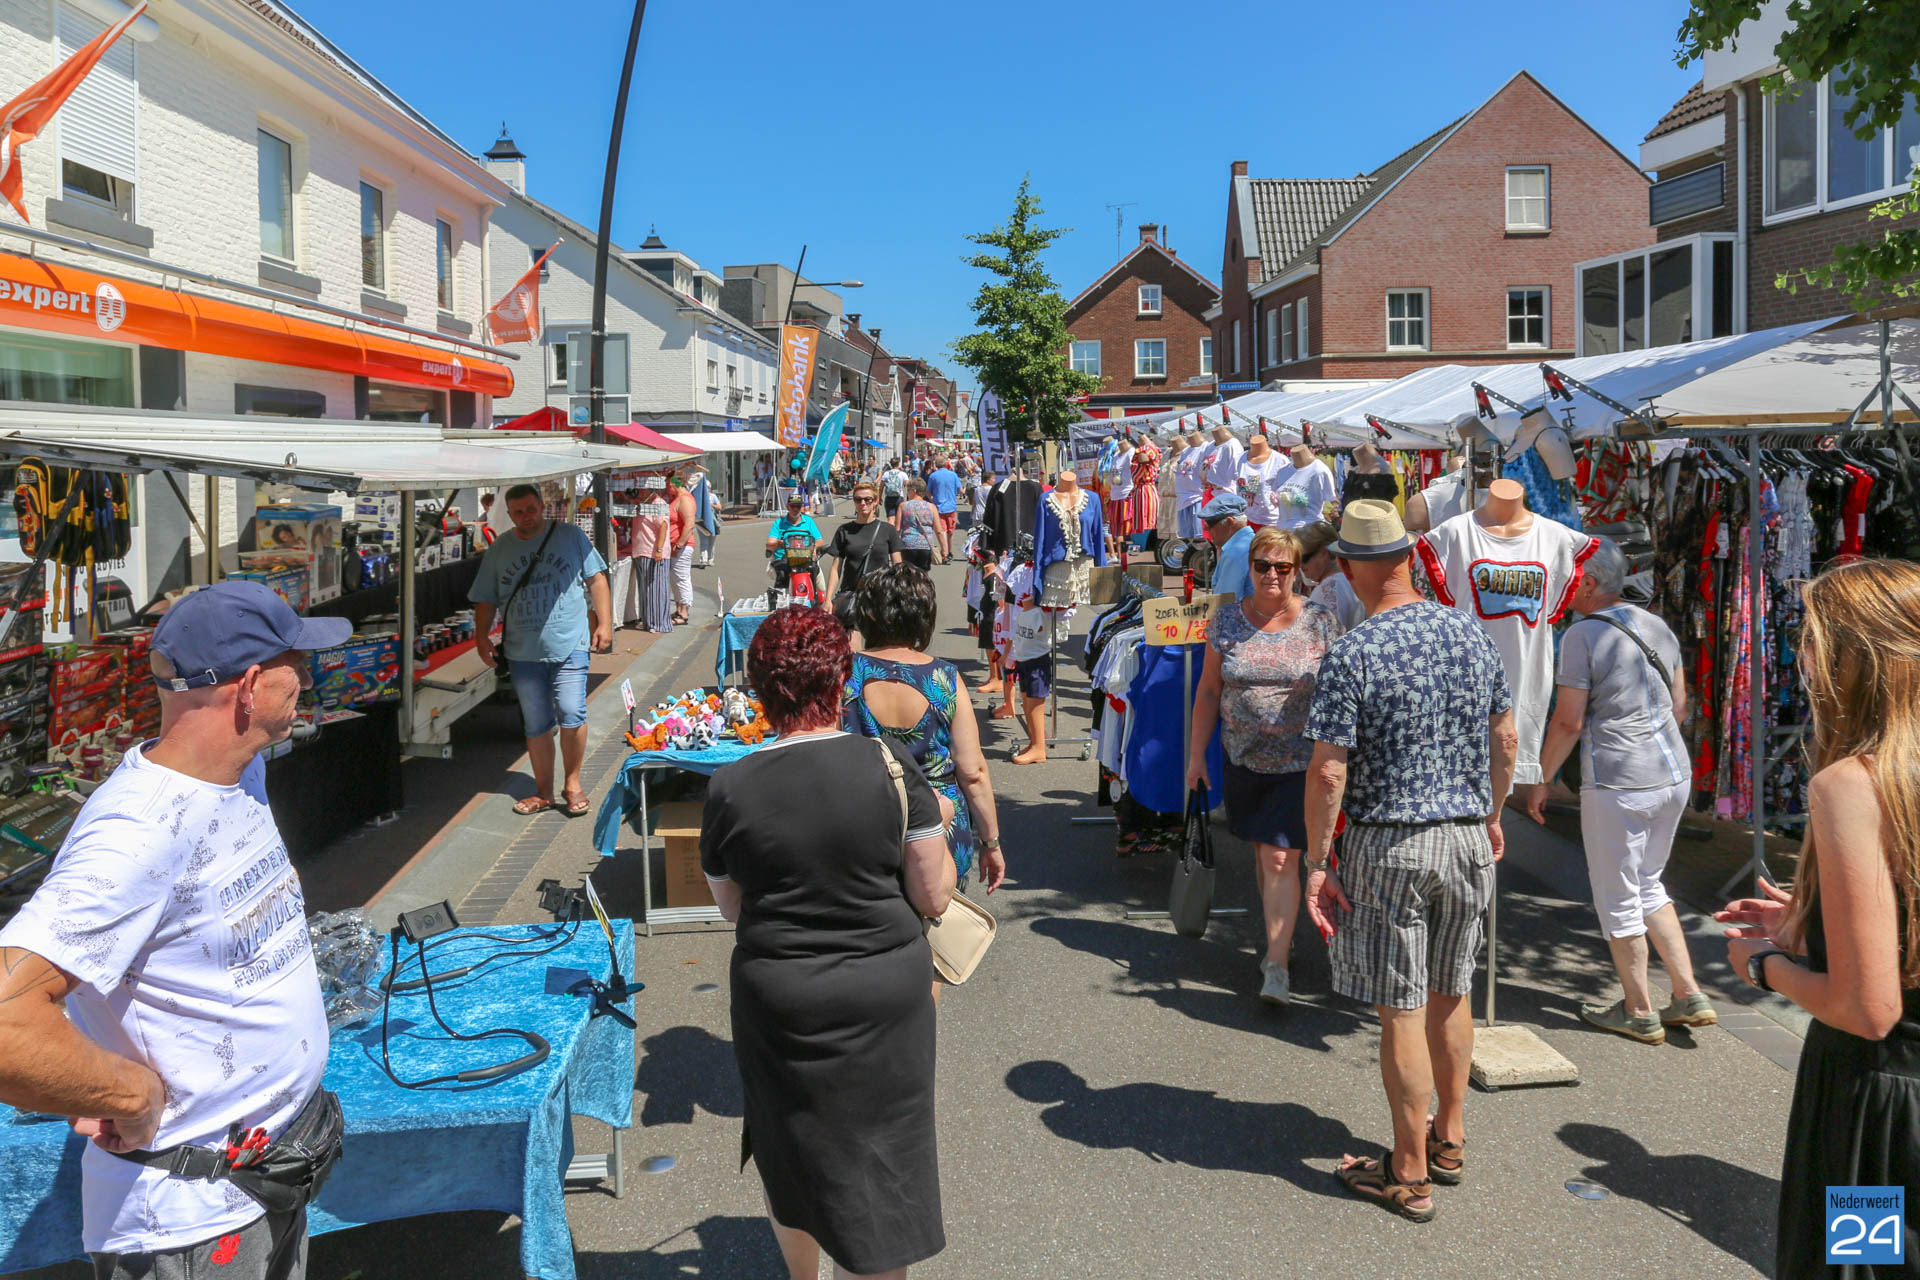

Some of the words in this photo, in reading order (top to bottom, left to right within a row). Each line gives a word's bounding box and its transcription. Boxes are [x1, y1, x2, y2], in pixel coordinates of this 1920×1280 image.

[0, 279, 90, 314] expert
[422, 361, 452, 376] expert
[783, 333, 811, 442] Rabobank
[97, 558, 126, 572] ADVIES
[1477, 568, 1543, 601] OHHH!
[1155, 608, 1179, 620] ZOEK
